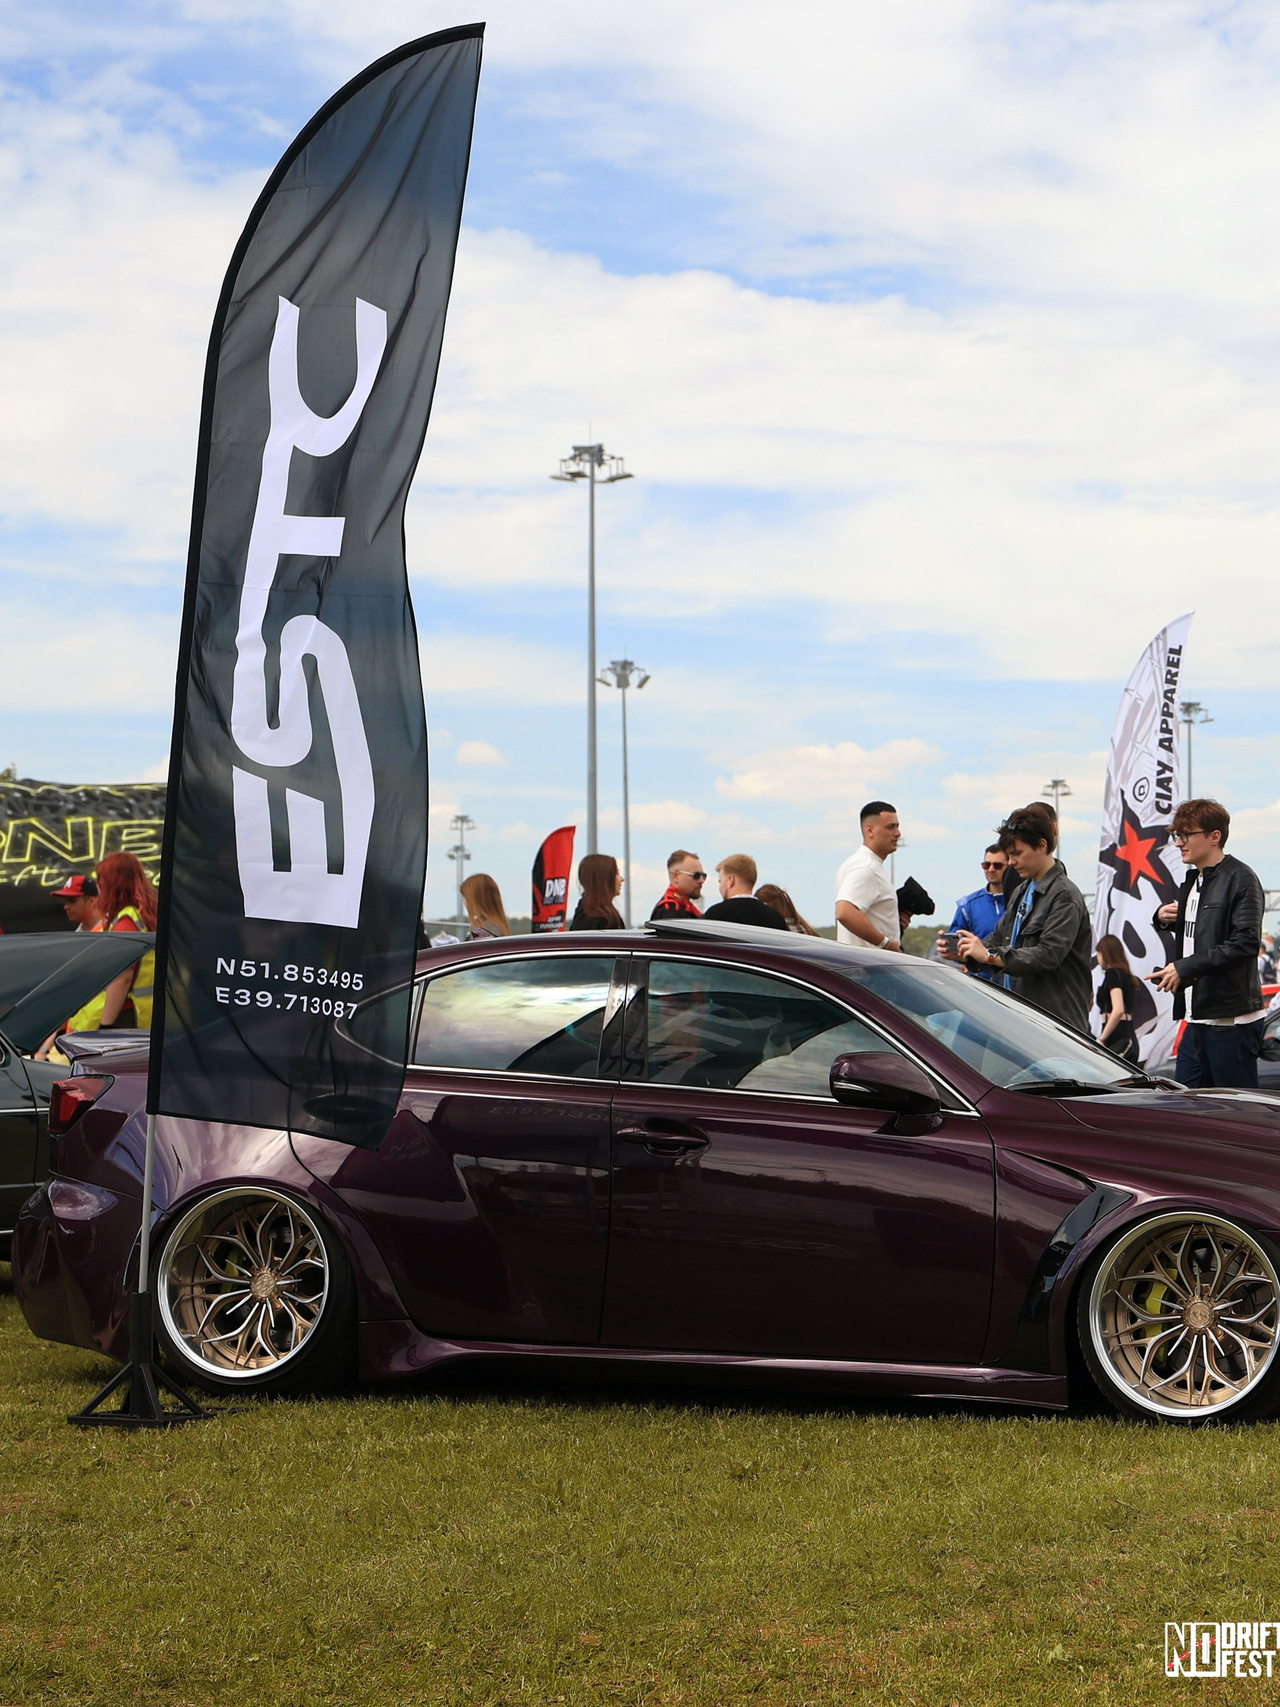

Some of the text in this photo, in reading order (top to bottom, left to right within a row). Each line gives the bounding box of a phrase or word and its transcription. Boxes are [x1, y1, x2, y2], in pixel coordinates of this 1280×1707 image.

[231, 295, 387, 929] ESTC
[1158, 645, 1183, 754] APPAREL
[215, 957, 364, 991] N51.853495
[215, 986, 358, 1020] E39.713087
